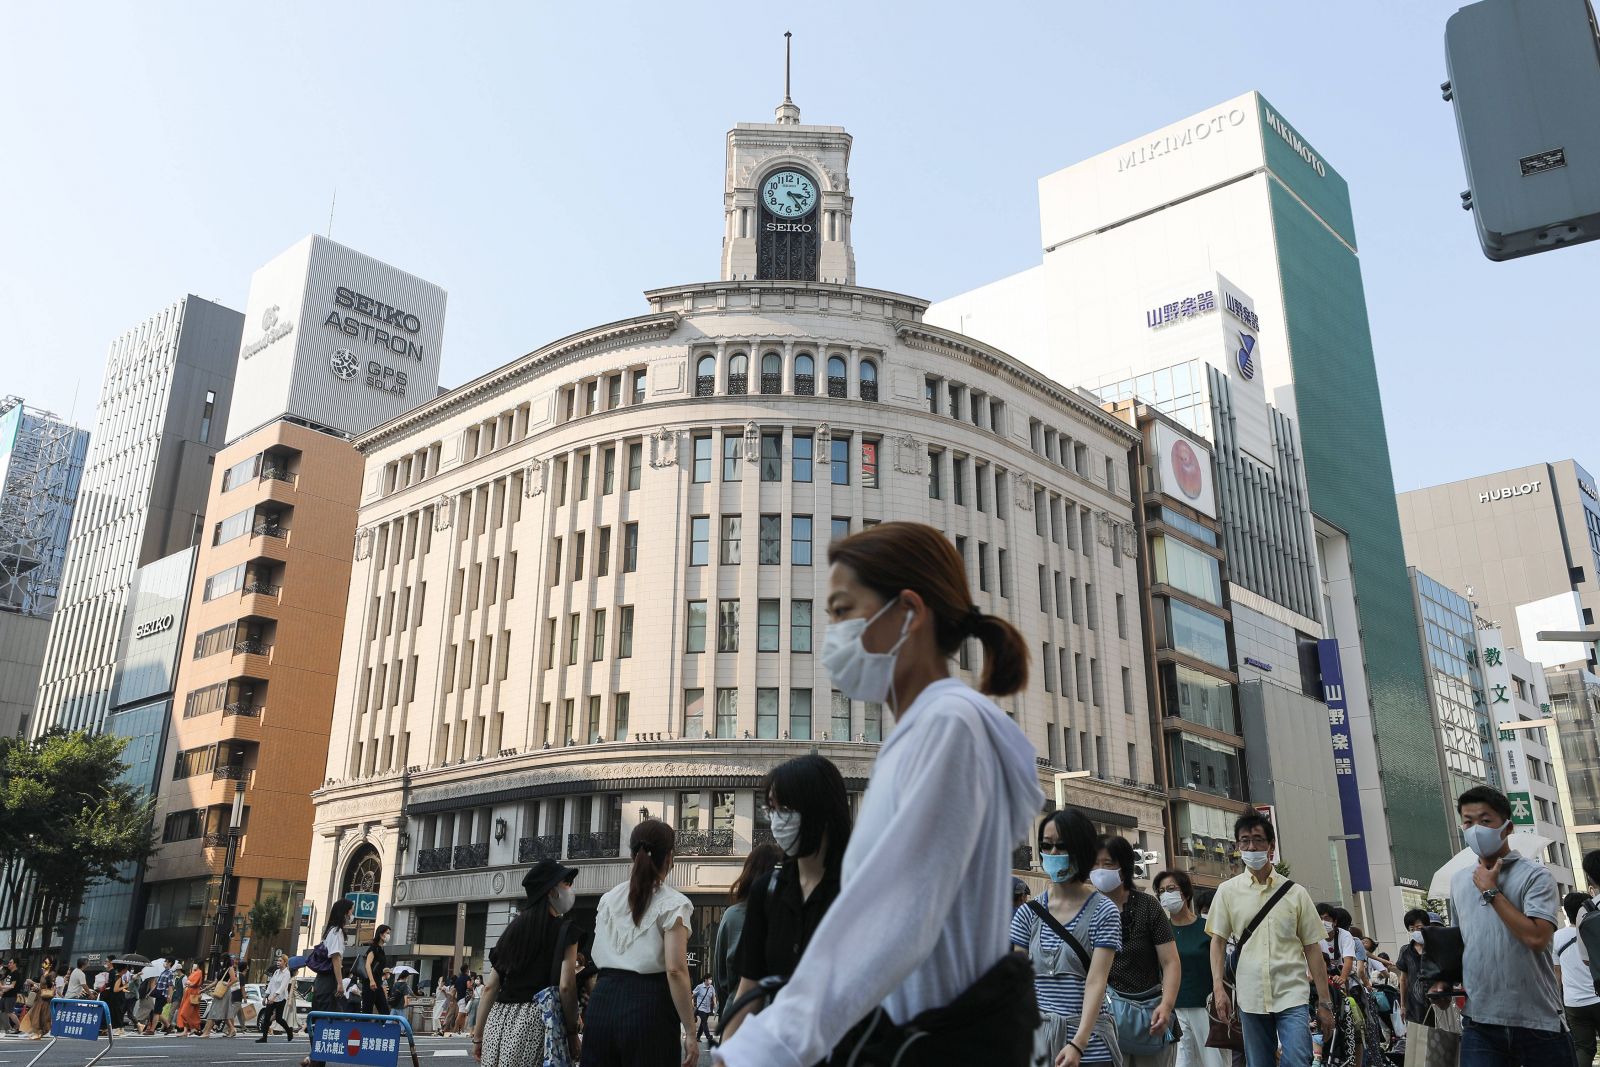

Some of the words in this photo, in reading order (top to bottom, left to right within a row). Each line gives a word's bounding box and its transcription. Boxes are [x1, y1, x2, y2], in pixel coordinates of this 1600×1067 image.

[1118, 109, 1245, 172] MIKIMOTO
[1265, 106, 1326, 178] MIKIMOTO
[778, 203, 784, 211] 7
[766, 222, 812, 233] SEIKO
[334, 286, 421, 334] SEIKO
[1147, 290, 1214, 328] 山野楽器
[1225, 291, 1260, 332] 山野楽器
[324, 311, 423, 362] ASTRON
[367, 360, 408, 386] GPS
[366, 376, 406, 398] SOLAR
[1479, 481, 1541, 503] HUBLOT
[136, 614, 174, 639] SEIKO
[1325, 685, 1352, 774] 山野楽器
[1508, 749, 1516, 769] SINCE
[1510, 798, 1530, 819] 本
[322, 1028, 340, 1041] 自転車
[315, 1041, 345, 1055] 乗入れ禁止
